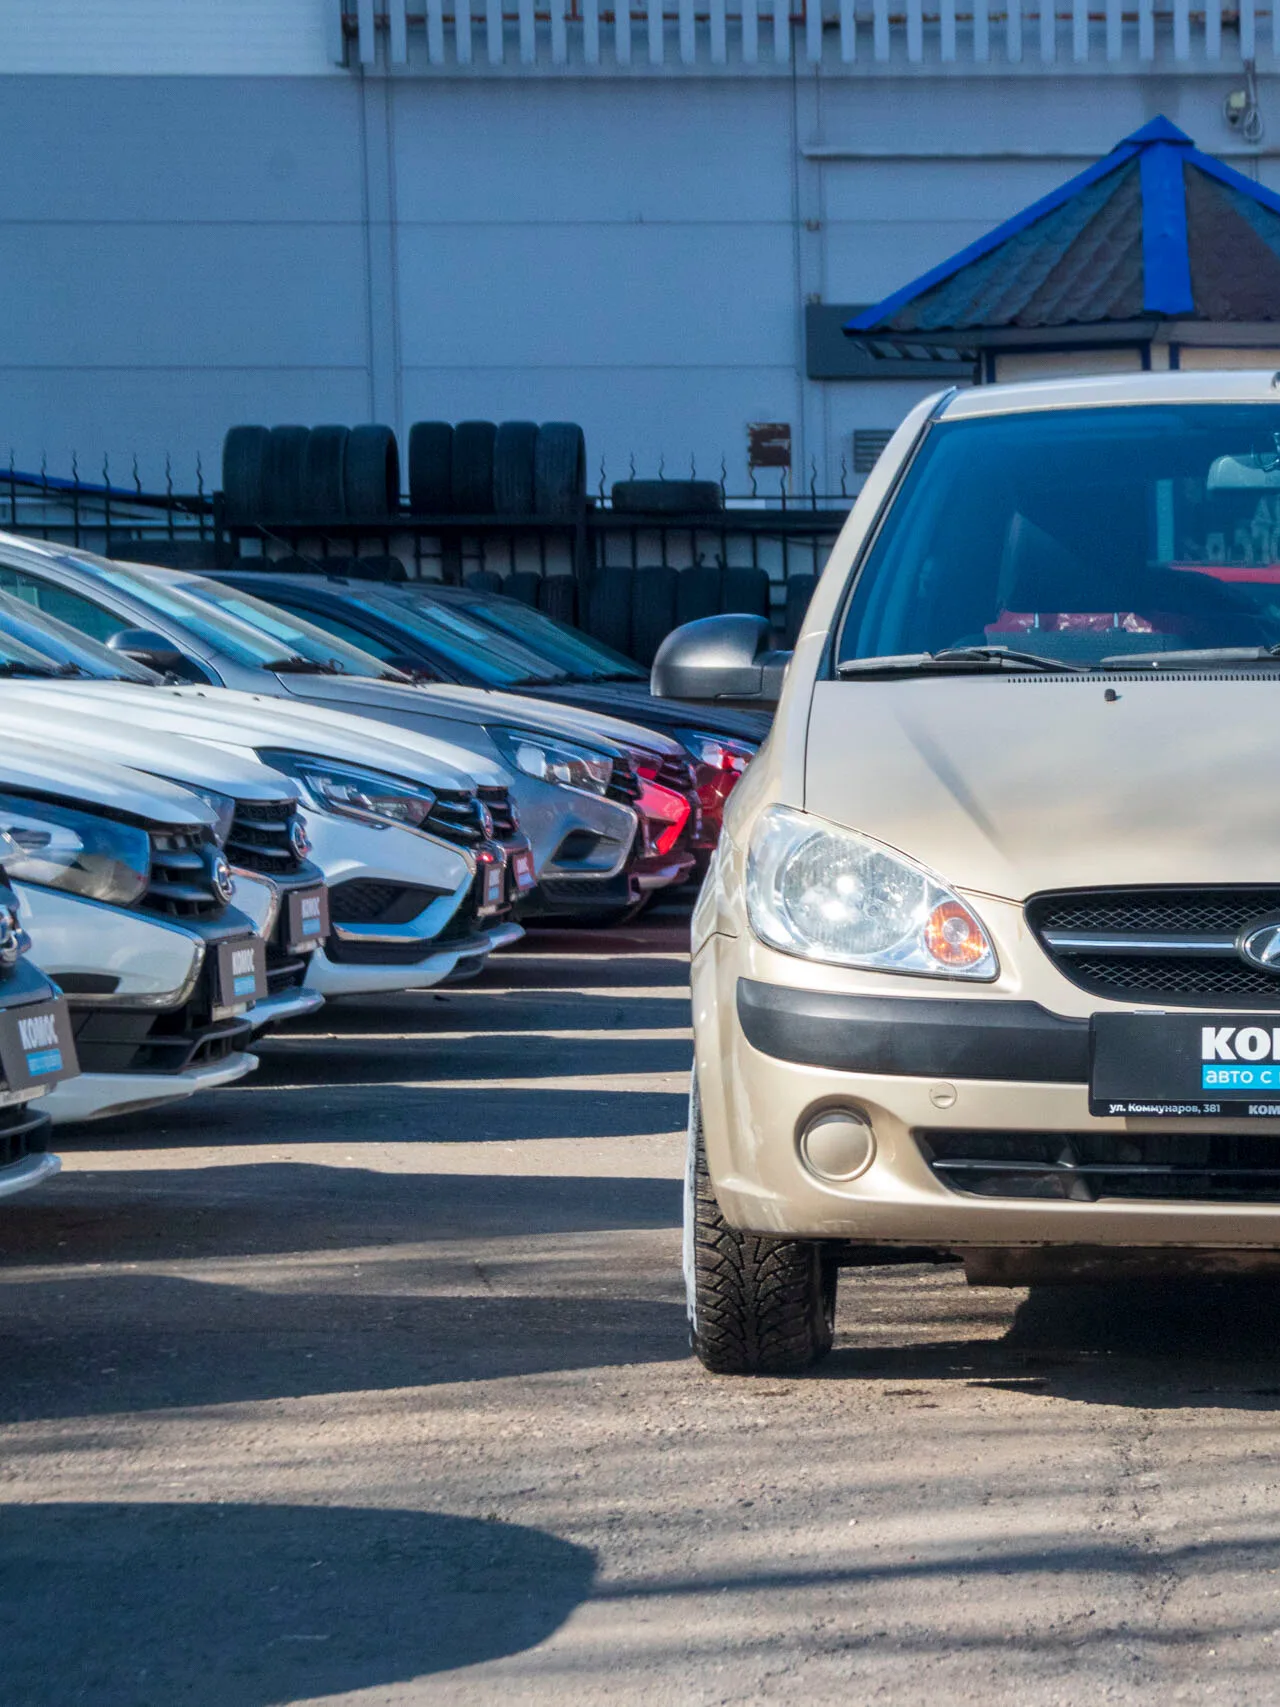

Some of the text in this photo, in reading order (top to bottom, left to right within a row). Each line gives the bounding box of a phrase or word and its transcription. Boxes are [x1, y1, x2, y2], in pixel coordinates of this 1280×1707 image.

[18, 1013, 59, 1050] КОМОС
[1205, 1070, 1254, 1084] авто
[1260, 1070, 1272, 1084] с
[1109, 1103, 1221, 1115] ул. Коммунаров, 381
